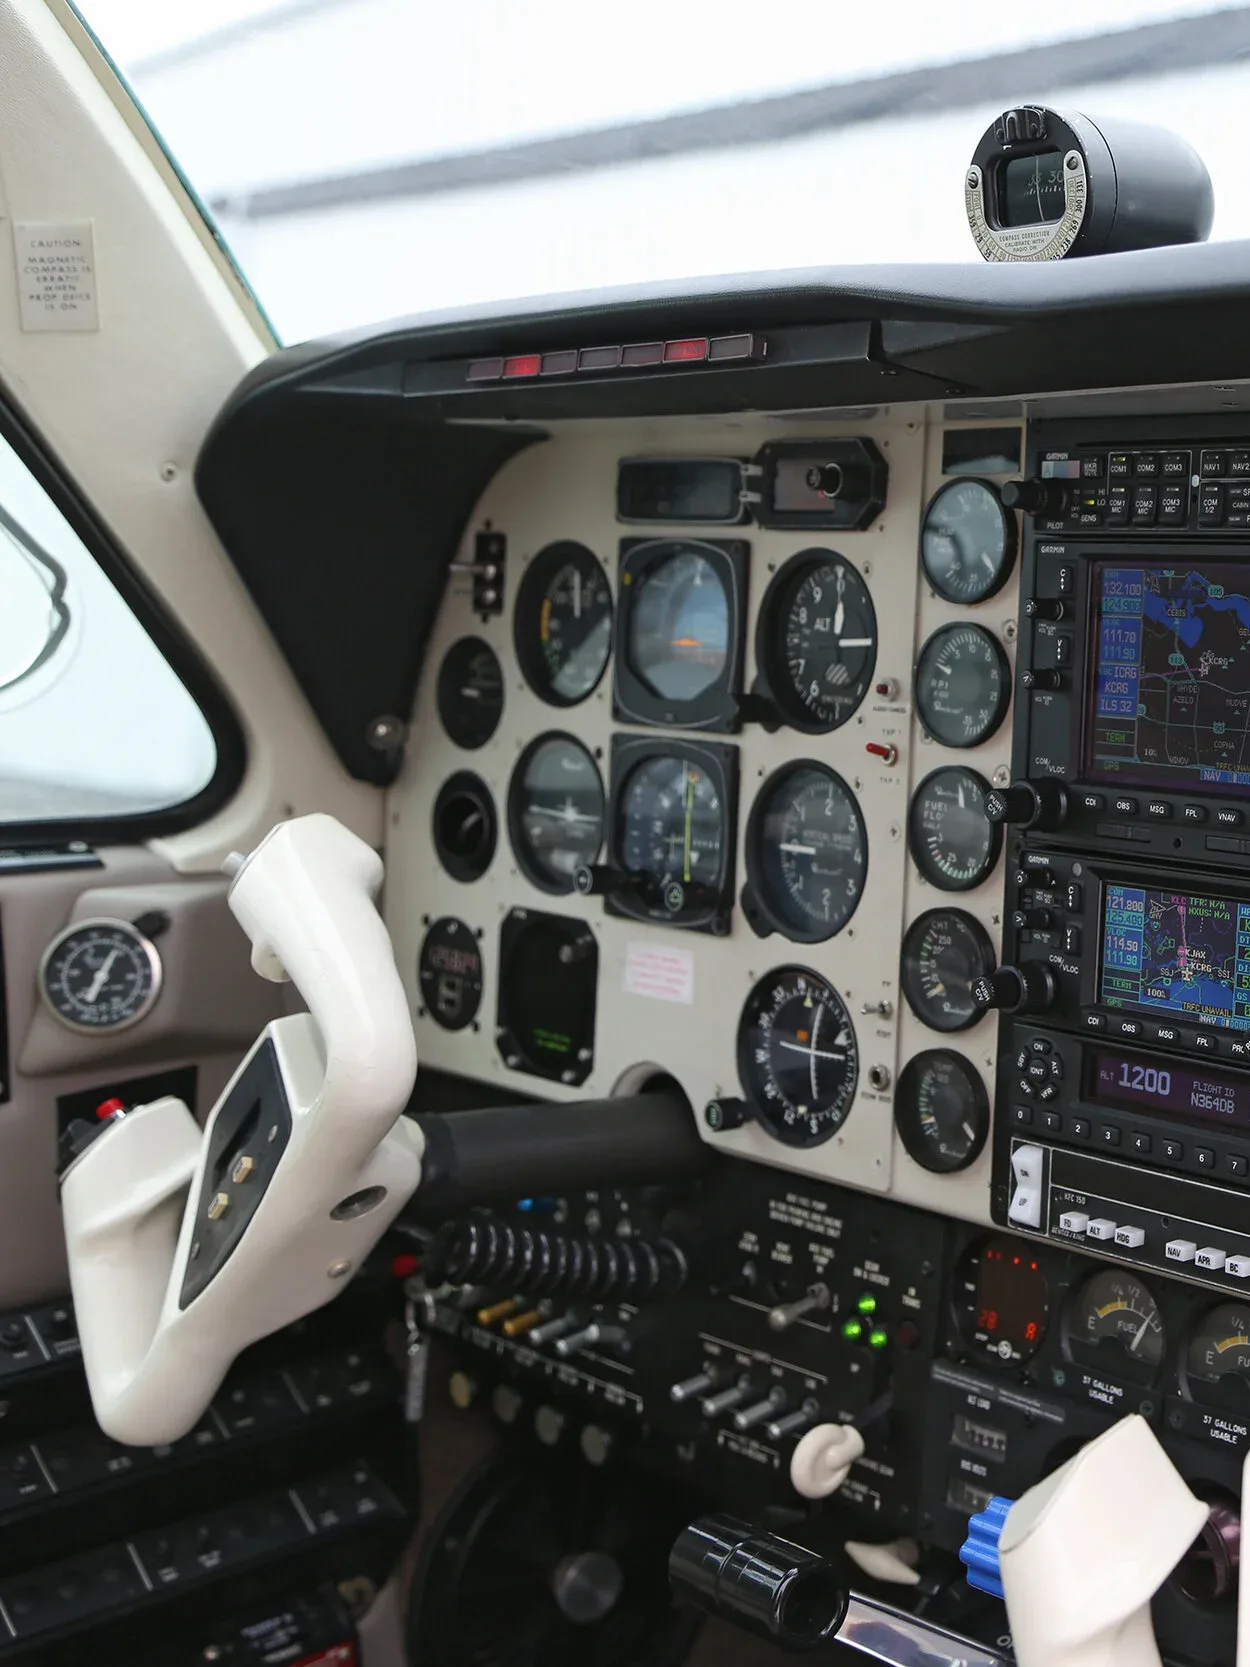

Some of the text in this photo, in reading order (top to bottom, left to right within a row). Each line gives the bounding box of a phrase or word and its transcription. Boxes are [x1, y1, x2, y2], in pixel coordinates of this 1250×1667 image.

[1137, 464, 1154, 472] COM2
[814, 618, 831, 631] ALT
[989, 794, 1003, 811] PUSH
[1117, 802, 1130, 810] OBS
[1150, 804, 1164, 814] MSG
[1185, 808, 1197, 818] FPL
[1218, 812, 1236, 822] VNAV
[1106, 896, 1144, 912] 121.800
[1158, 1029, 1173, 1040] MSG
[1119, 1063, 1171, 1096] 1200
[1193, 1081, 1222, 1095] FLIGHT
[1191, 1092, 1235, 1114] N364DB
[1090, 1226, 1101, 1236] ALT
[1167, 1246, 1181, 1257] NAV
[1198, 1255, 1210, 1266] APR
[1230, 1263, 1239, 1274] BC
[1117, 1321, 1138, 1334] FUEL
[1093, 1380, 1123, 1396] GALLONS
[1088, 1389, 1114, 1404] USABLE
[1203, 1415, 1247, 1435] 37 GALLONS
[1210, 1429, 1237, 1444] USABLE
